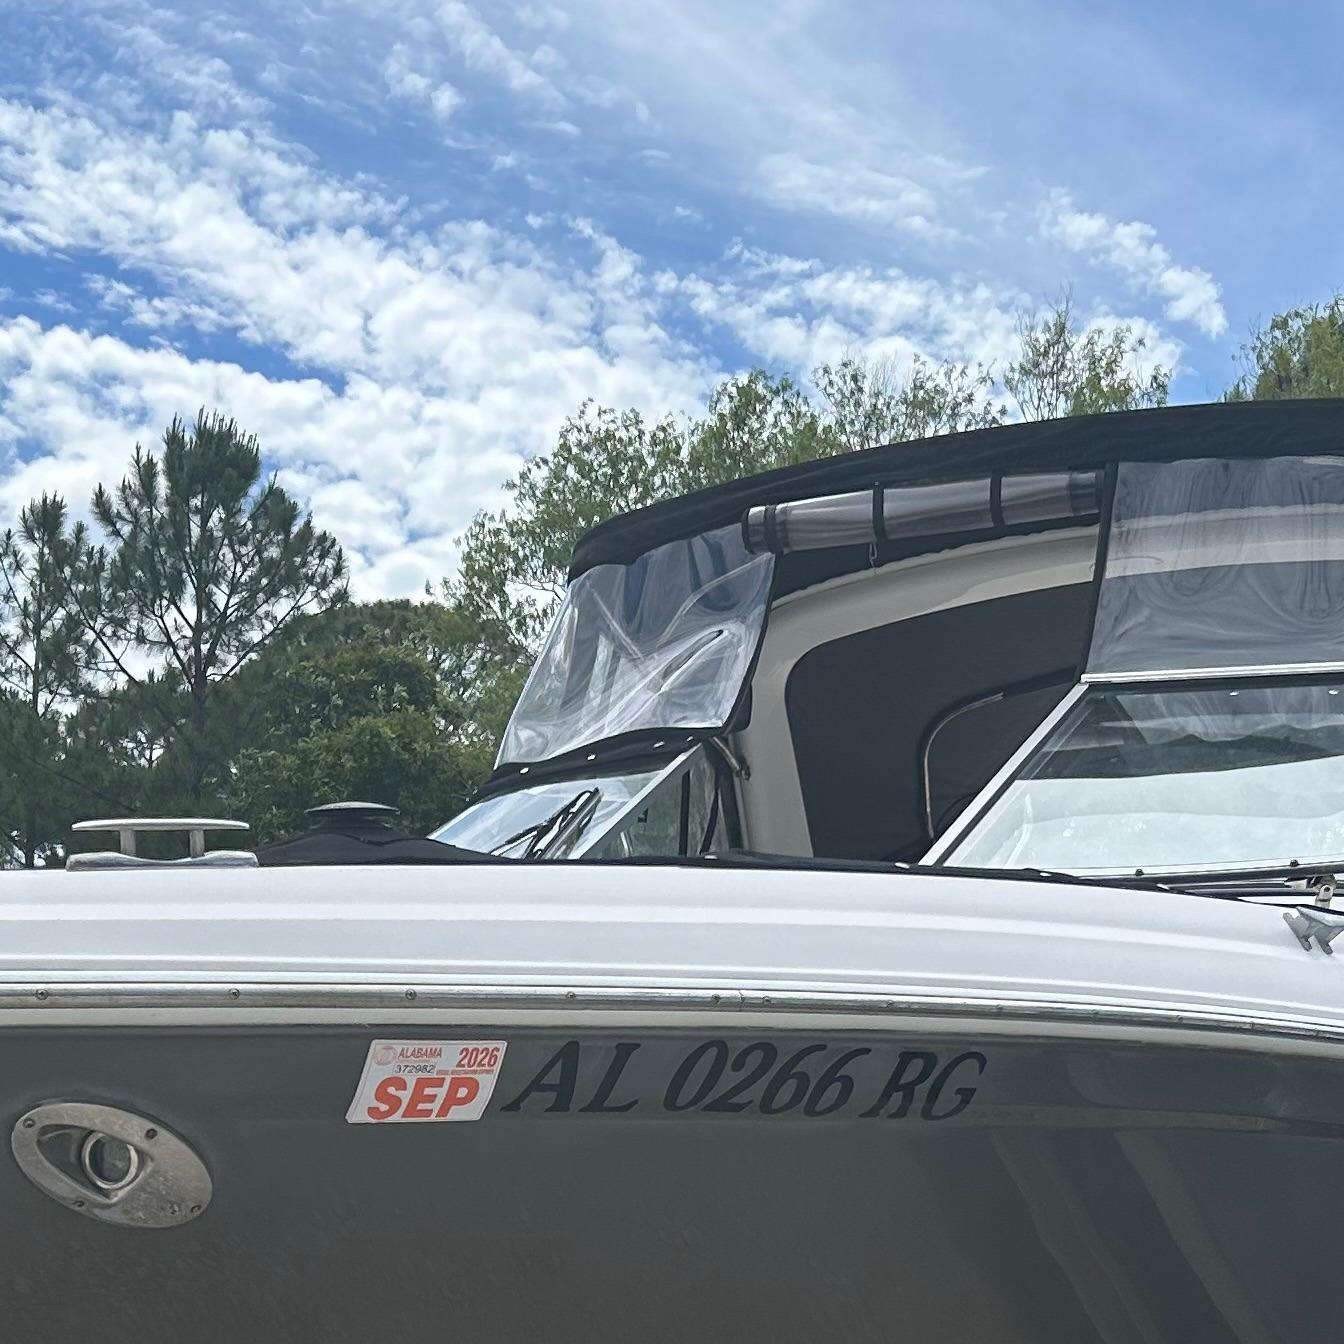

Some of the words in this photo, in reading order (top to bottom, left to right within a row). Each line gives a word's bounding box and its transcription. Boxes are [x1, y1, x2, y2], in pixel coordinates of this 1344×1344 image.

[398, 1047, 443, 1059] ALABAMA
[456, 1047, 500, 1069] 2026
[367, 1076, 480, 1120] SEP
[499, 1040, 641, 1113] AL
[663, 1040, 872, 1118] 0266
[858, 1051, 988, 1121] RG
